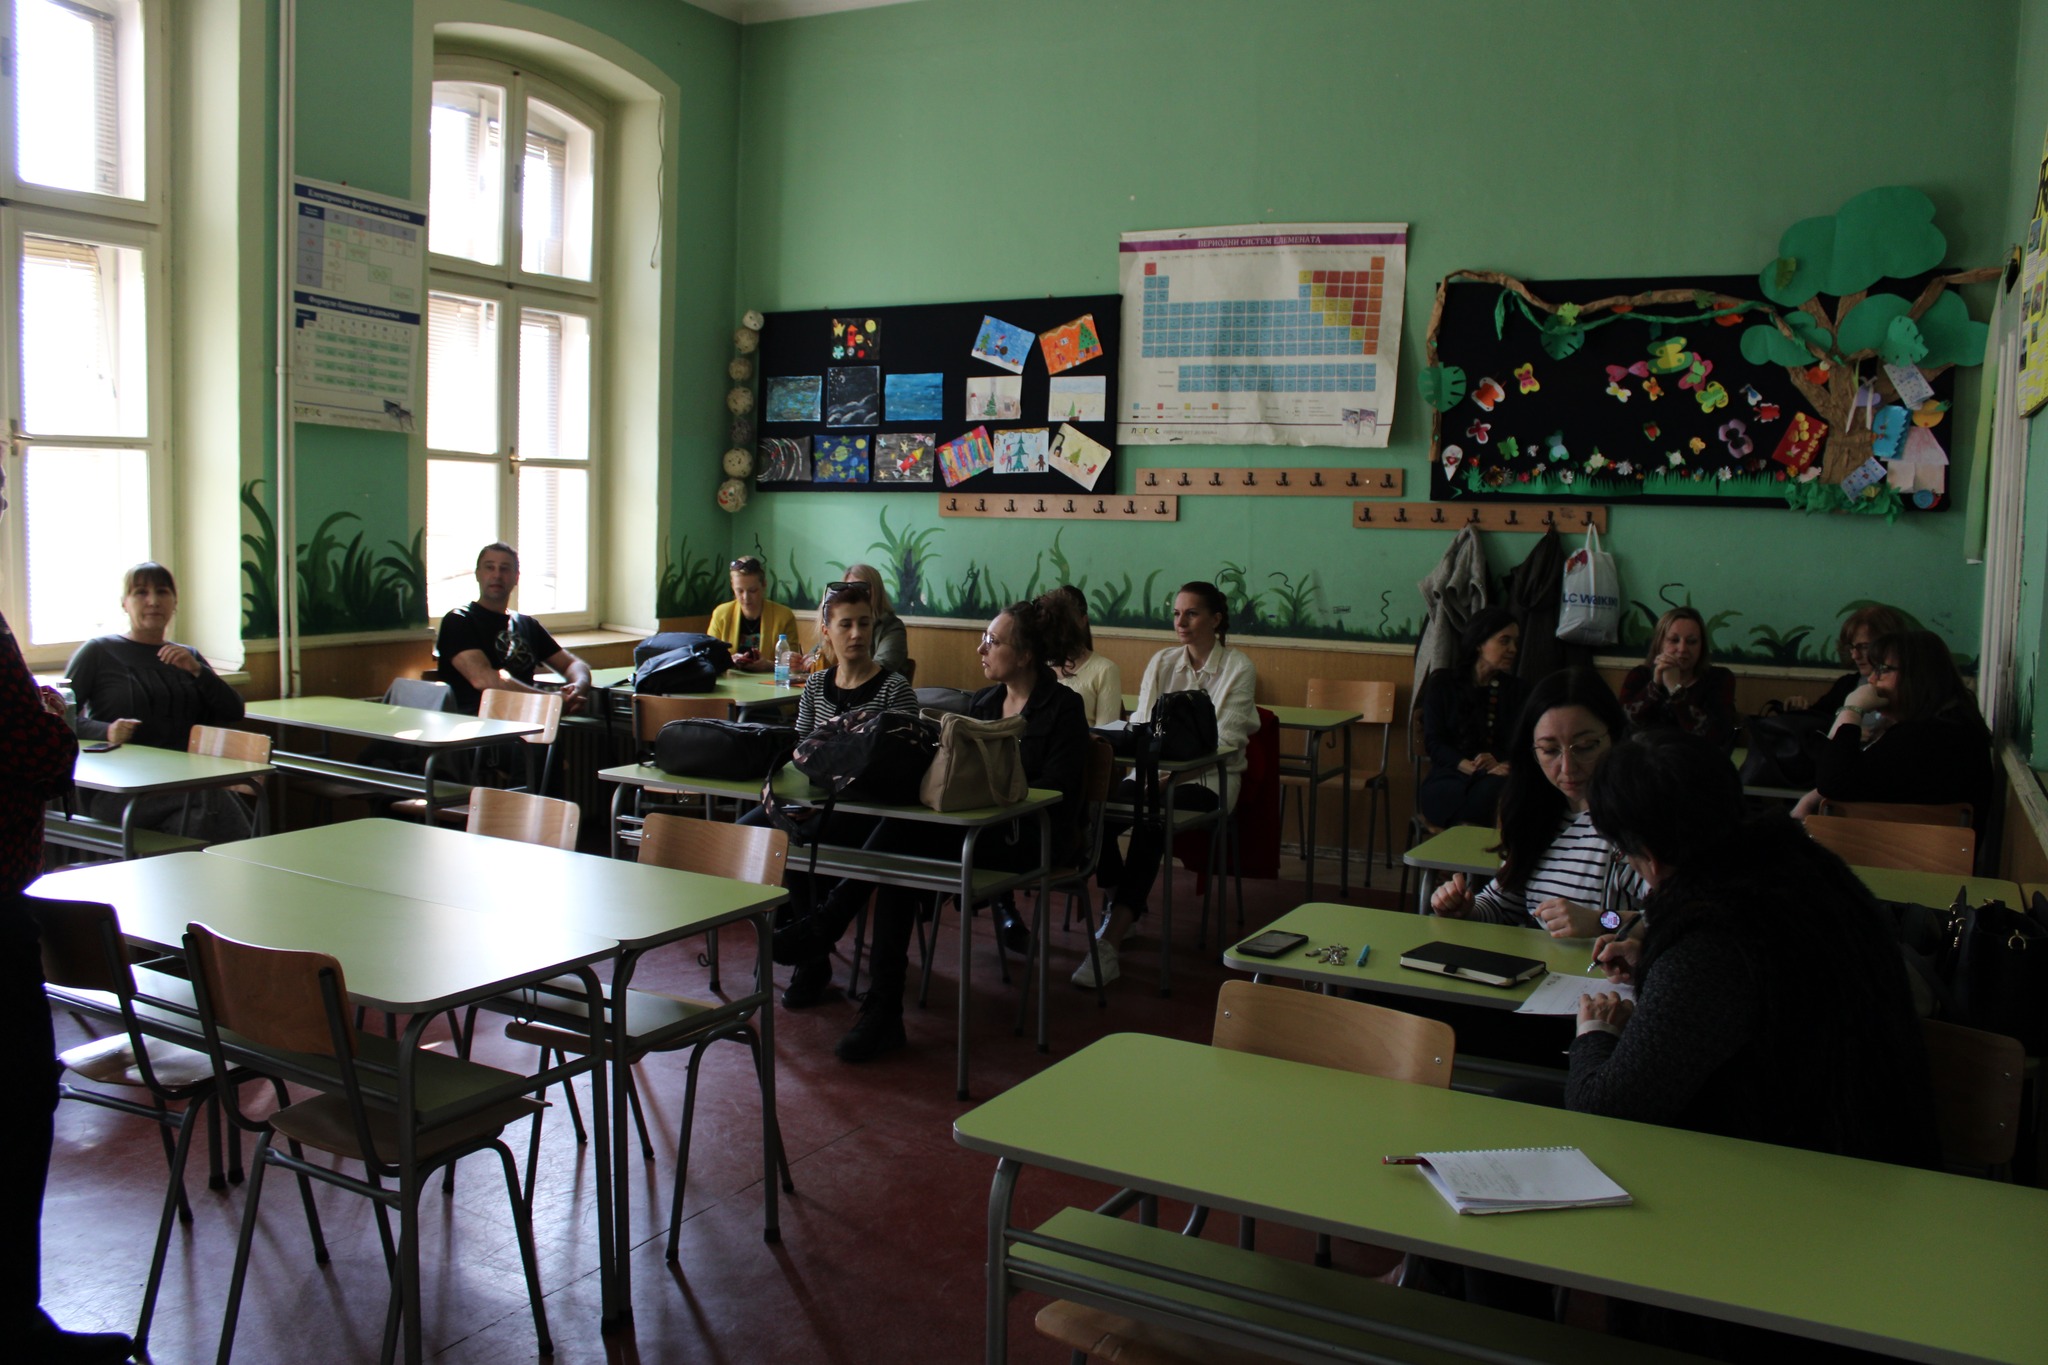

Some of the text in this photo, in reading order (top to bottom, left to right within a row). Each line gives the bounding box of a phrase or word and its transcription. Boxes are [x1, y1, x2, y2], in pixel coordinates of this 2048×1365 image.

[1198, 236, 1321, 248] ПЕРИОДНИ СИСТЕМ ЕЛЕМЕНАТА
[1562, 593, 1578, 603] LC
